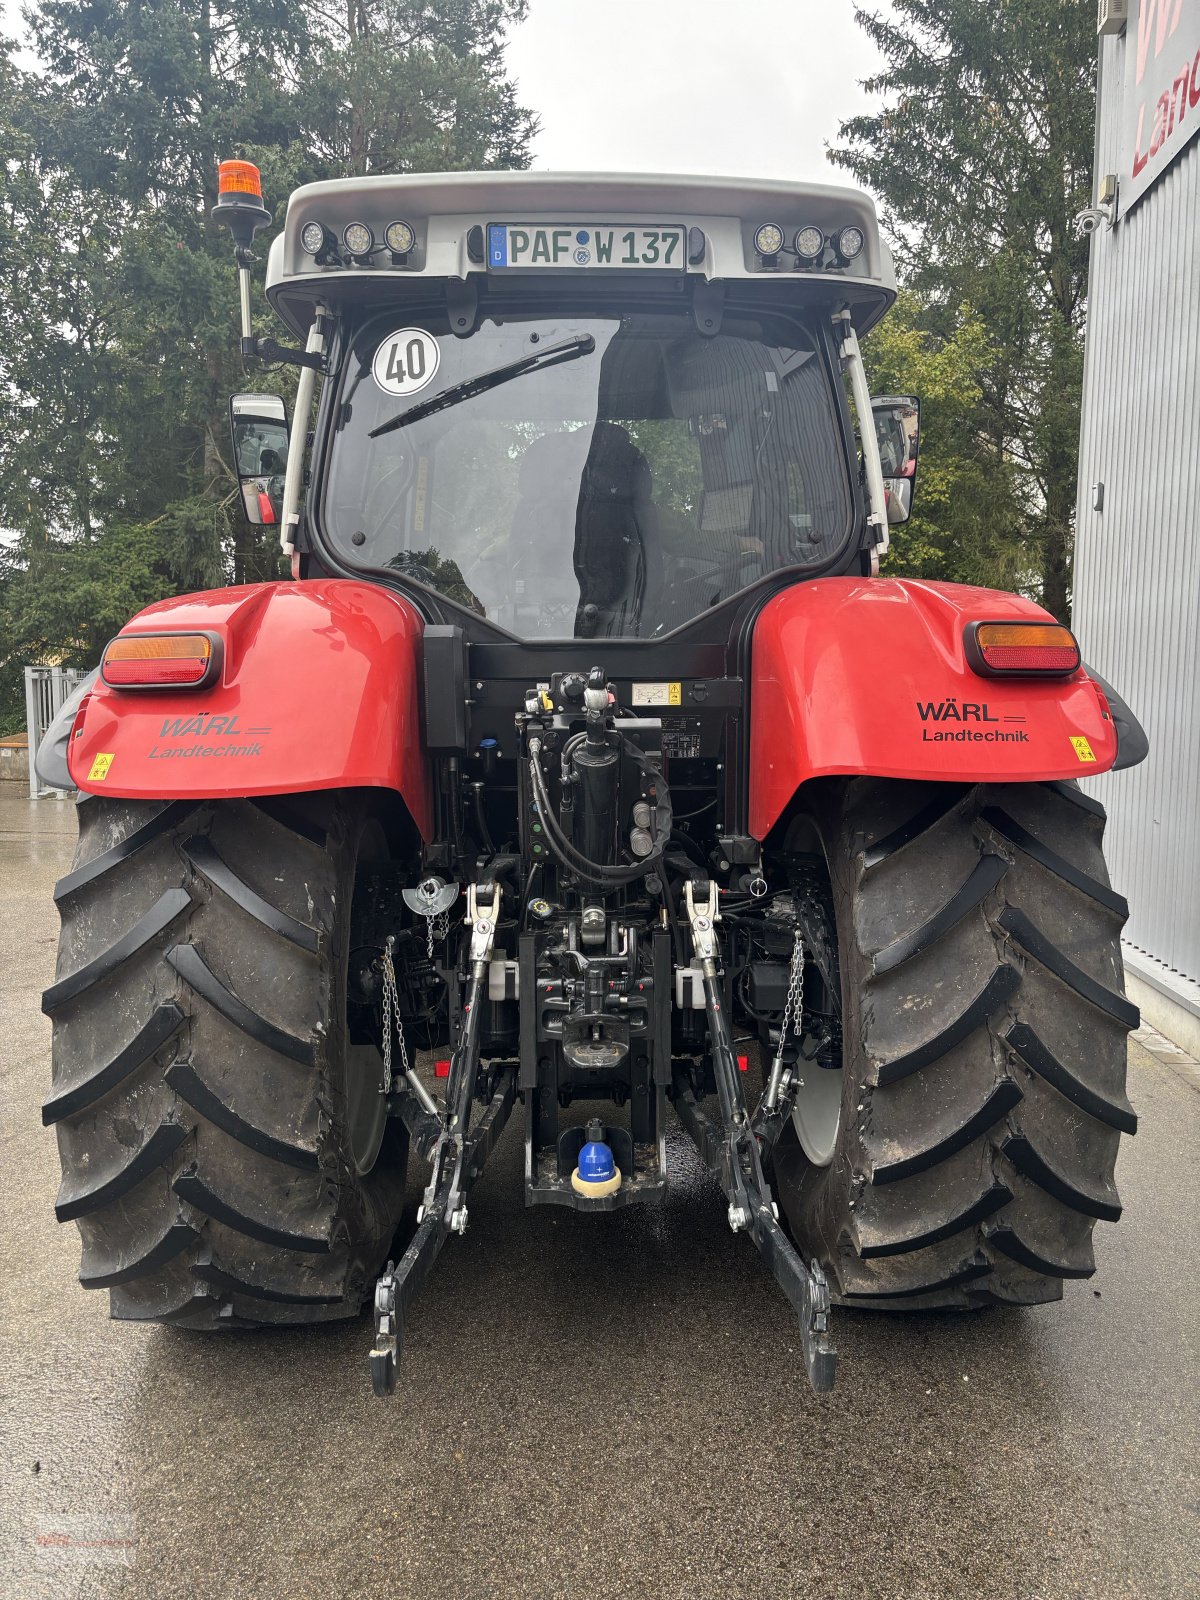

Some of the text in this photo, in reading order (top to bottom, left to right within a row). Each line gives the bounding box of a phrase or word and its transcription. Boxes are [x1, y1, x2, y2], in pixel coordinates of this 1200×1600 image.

[494, 250, 502, 261] D
[509, 230, 680, 265] PAF W 137
[386, 339, 426, 384] 40
[916, 698, 999, 722] WÄRL
[159, 711, 241, 738] WÄRL
[922, 728, 1030, 742] Landtechnik
[148, 742, 264, 760] Landtechnik
